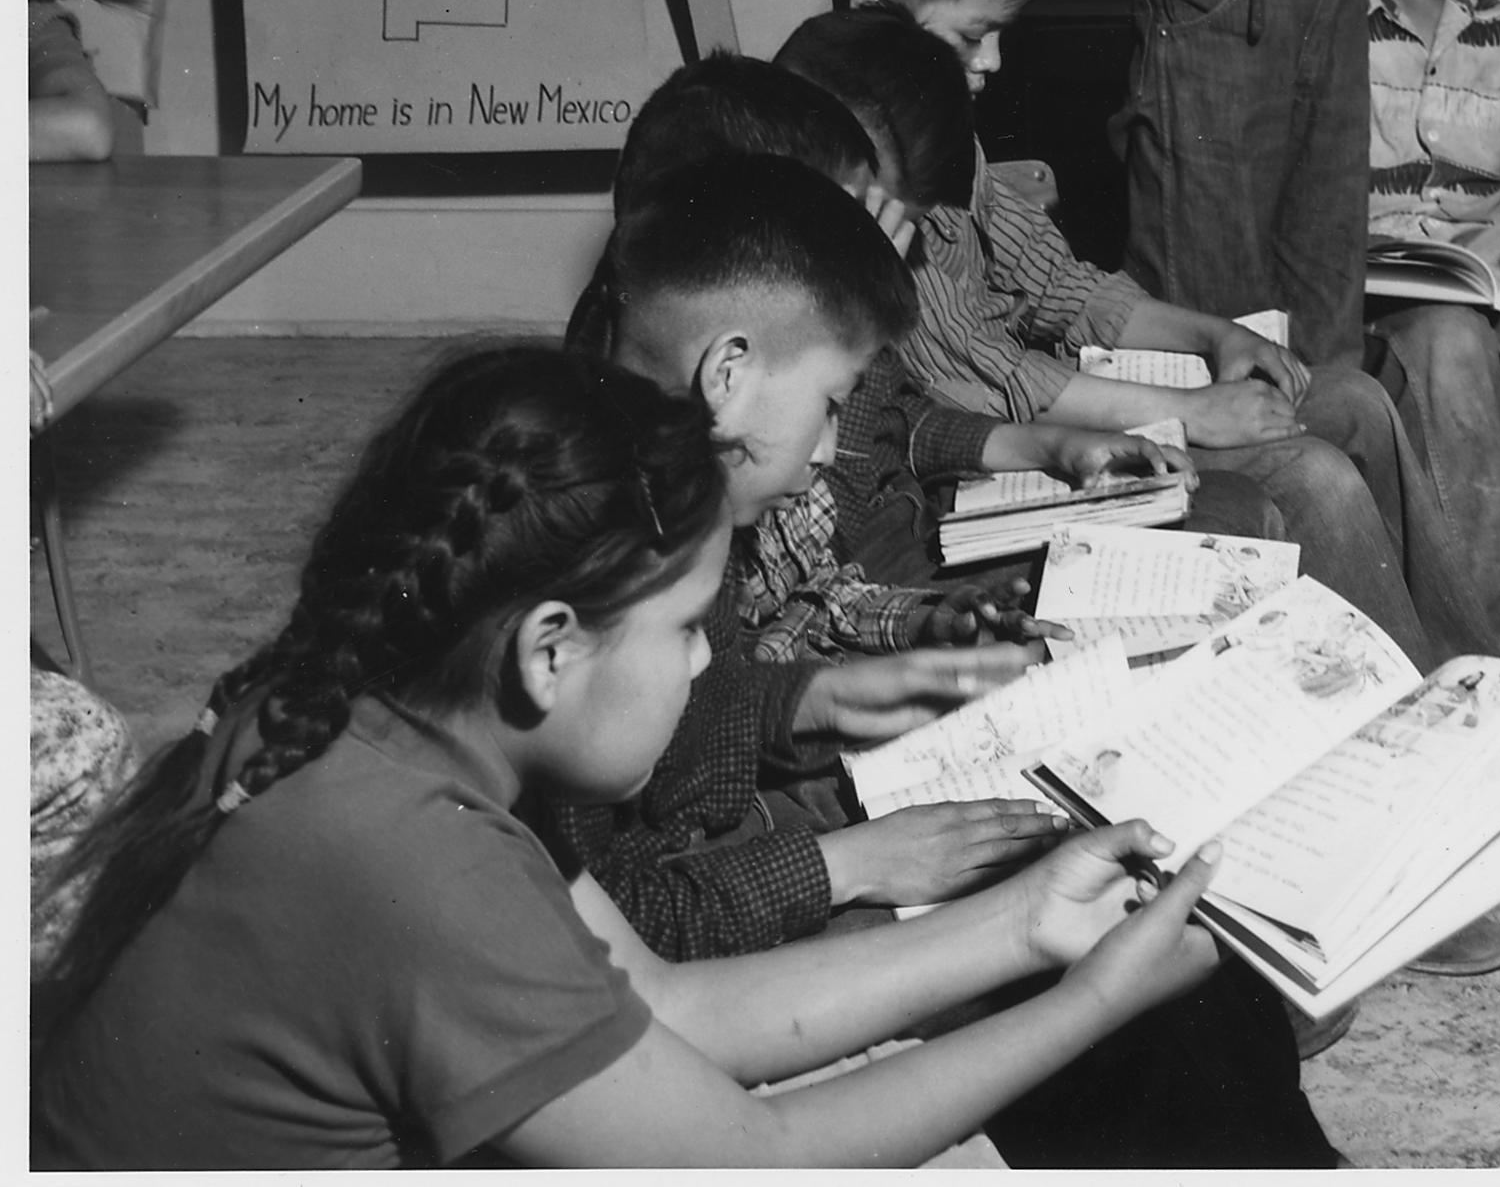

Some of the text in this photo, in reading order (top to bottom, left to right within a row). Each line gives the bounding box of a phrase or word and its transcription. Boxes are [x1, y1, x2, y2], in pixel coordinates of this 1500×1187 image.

[253, 81, 297, 143] My
[308, 83, 378, 127] home
[392, 98, 413, 126] is
[427, 97, 453, 126] in
[468, 82, 529, 126] New
